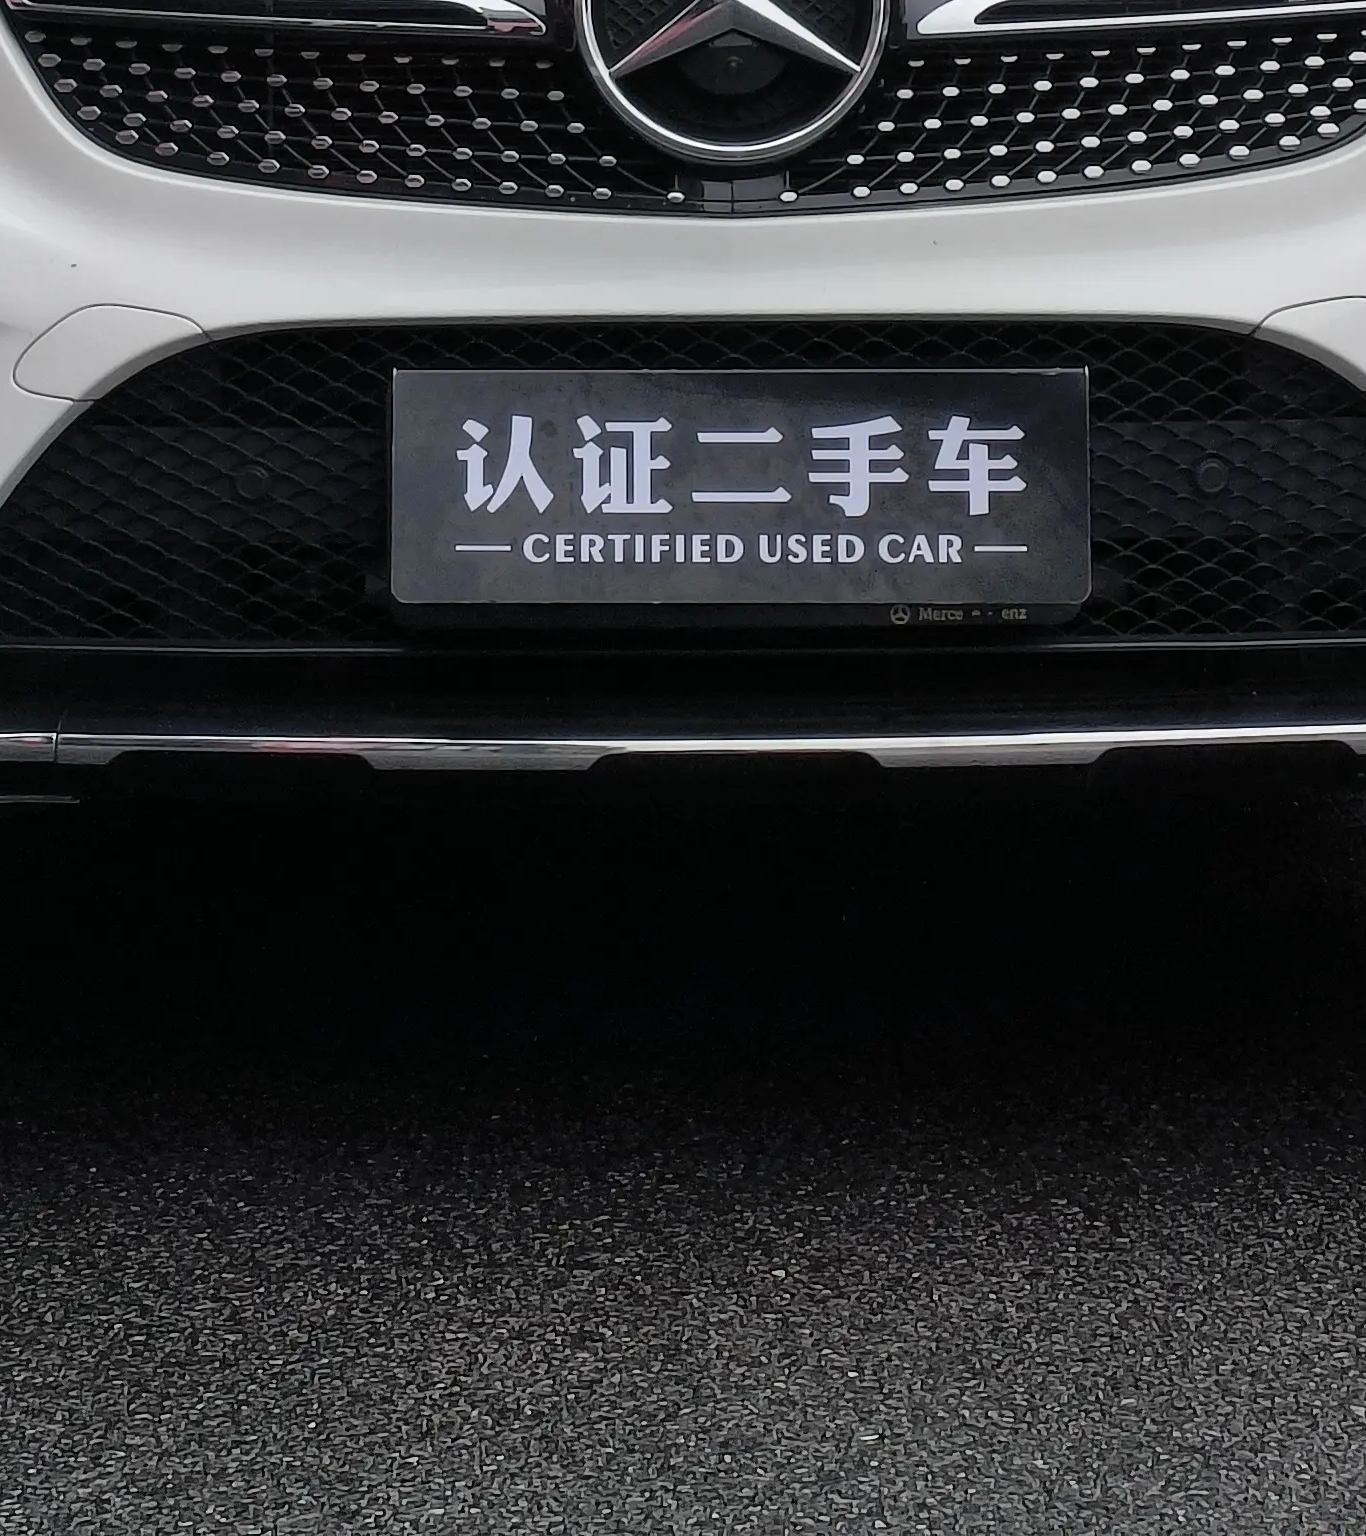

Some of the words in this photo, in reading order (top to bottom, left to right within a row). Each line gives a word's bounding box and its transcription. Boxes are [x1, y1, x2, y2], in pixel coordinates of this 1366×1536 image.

[456, 415, 1027, 517] 认证二手车
[522, 533, 744, 563] CERTIFIED
[759, 534, 865, 564] USED
[878, 534, 962, 564] CAR
